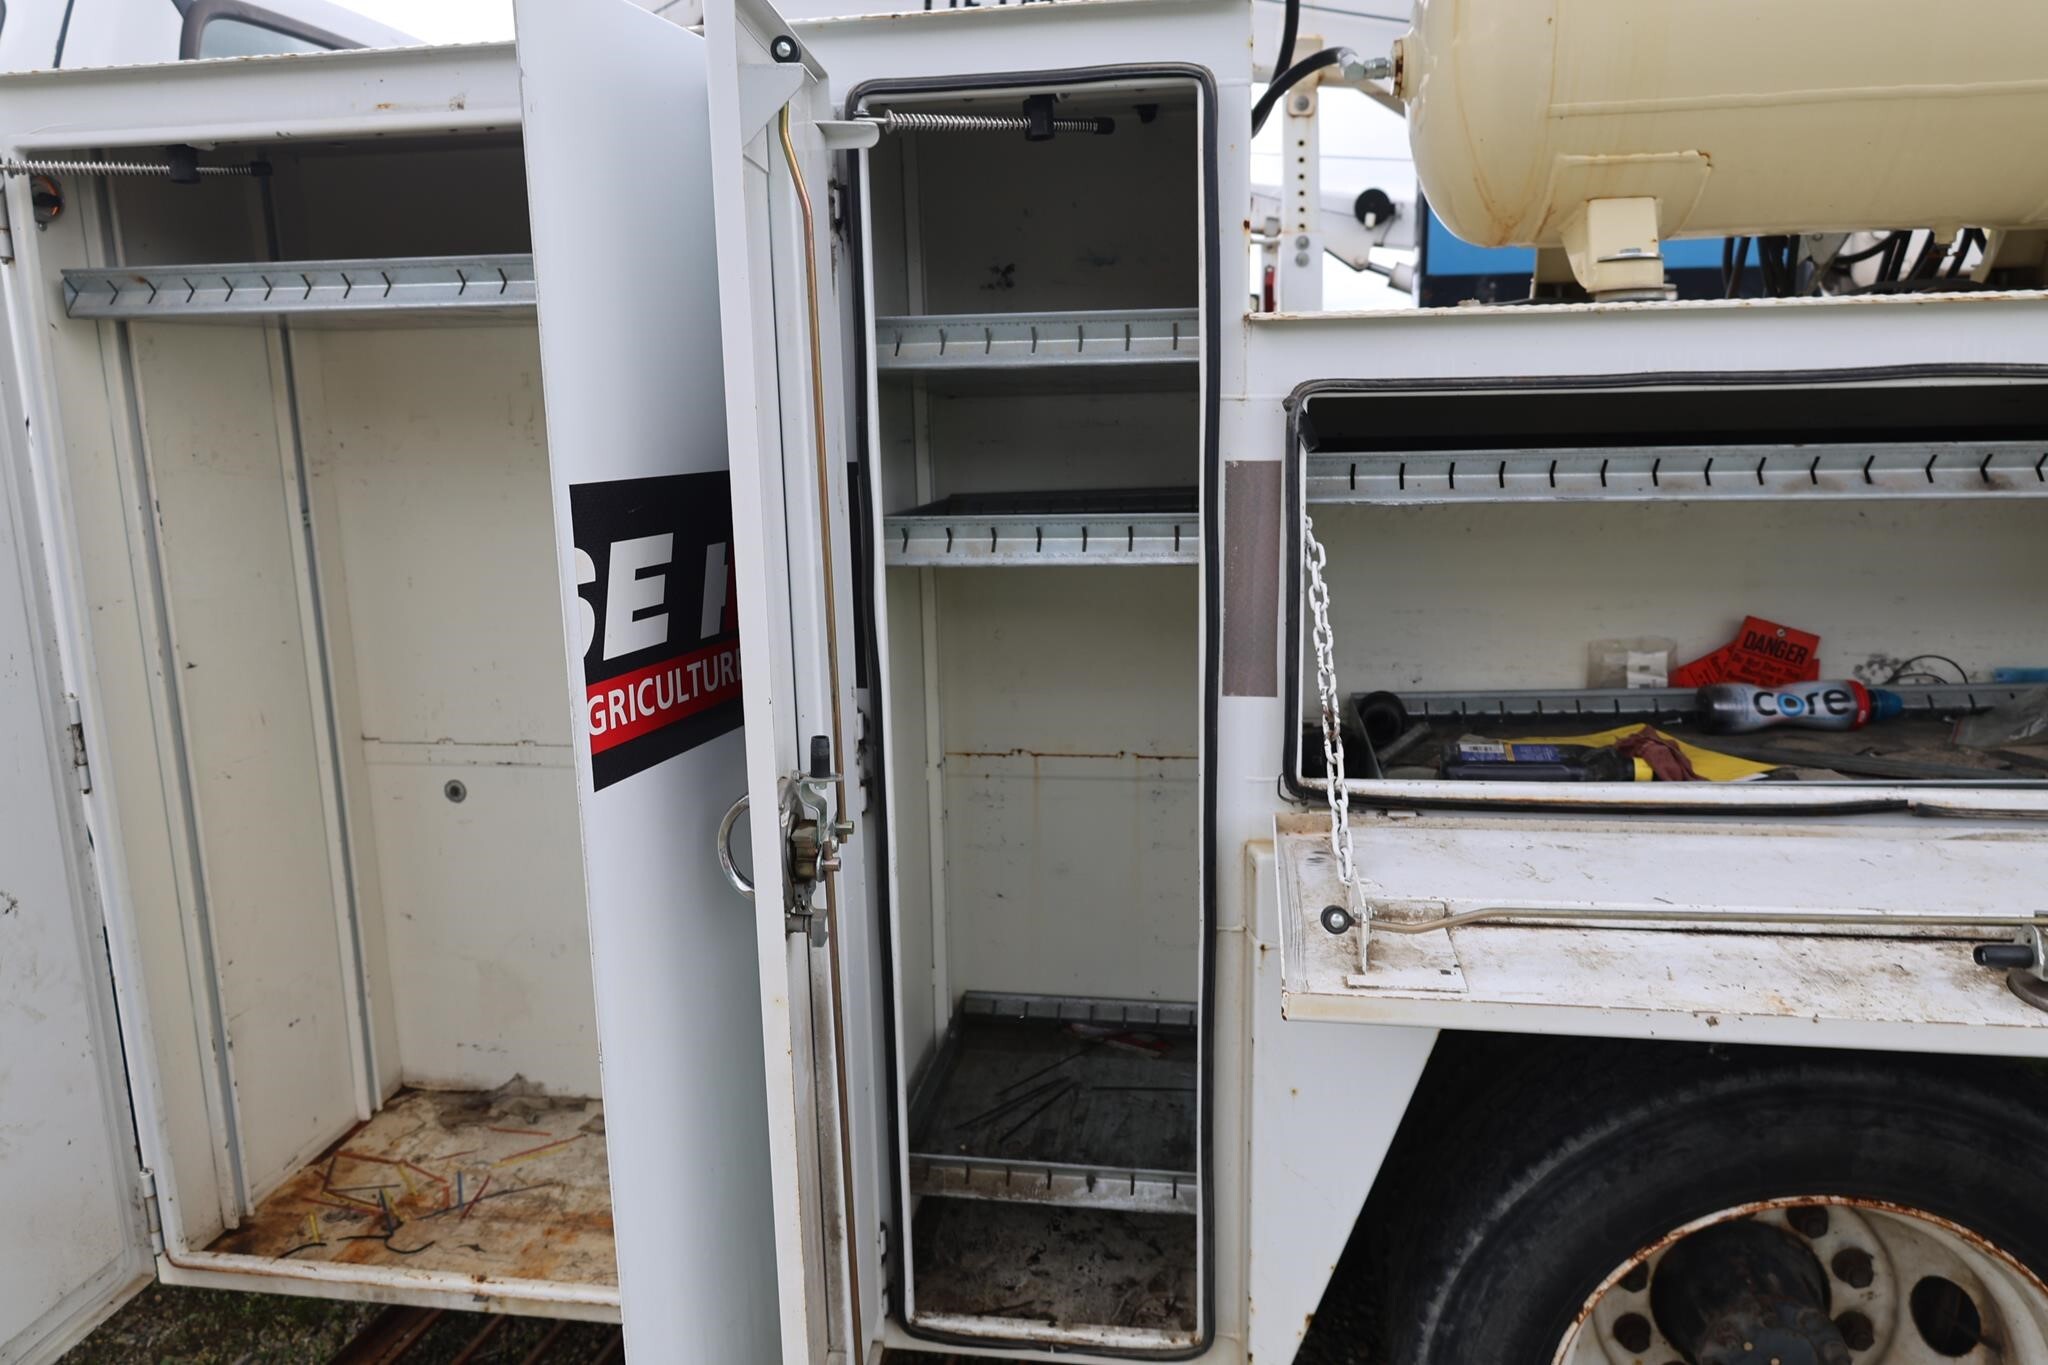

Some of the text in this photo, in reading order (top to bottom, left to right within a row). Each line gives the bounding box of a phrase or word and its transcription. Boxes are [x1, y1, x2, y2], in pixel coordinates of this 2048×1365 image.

[1743, 630, 1809, 665] DANGER
[587, 648, 742, 736] GRICULTUR
[1753, 689, 1850, 716] core
